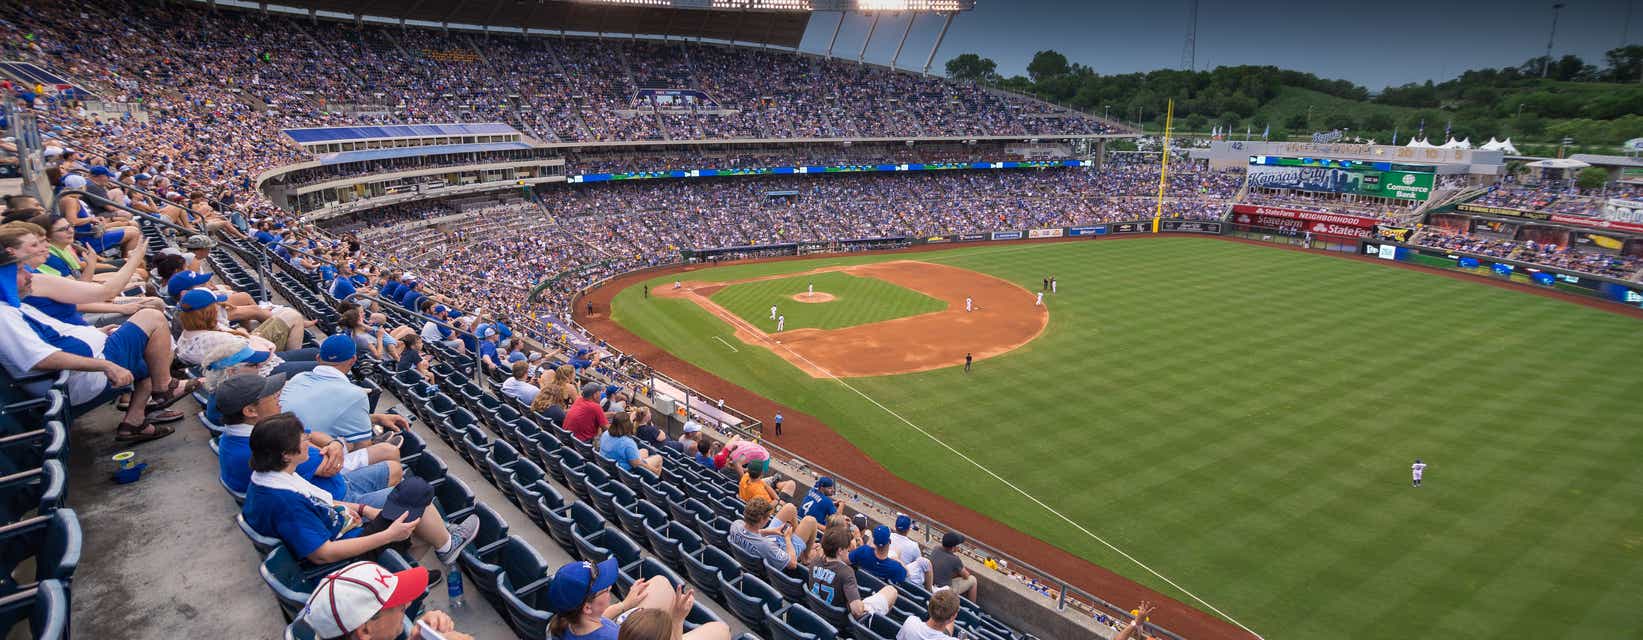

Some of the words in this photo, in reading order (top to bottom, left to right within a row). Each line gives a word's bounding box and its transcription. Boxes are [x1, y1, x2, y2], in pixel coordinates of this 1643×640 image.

[1386, 183, 1429, 193] Commerce
[1396, 190, 1417, 199] Bank
[1298, 212, 1360, 225] NEIGHBORHOOD
[802, 500, 814, 515] 4
[374, 567, 392, 588] K
